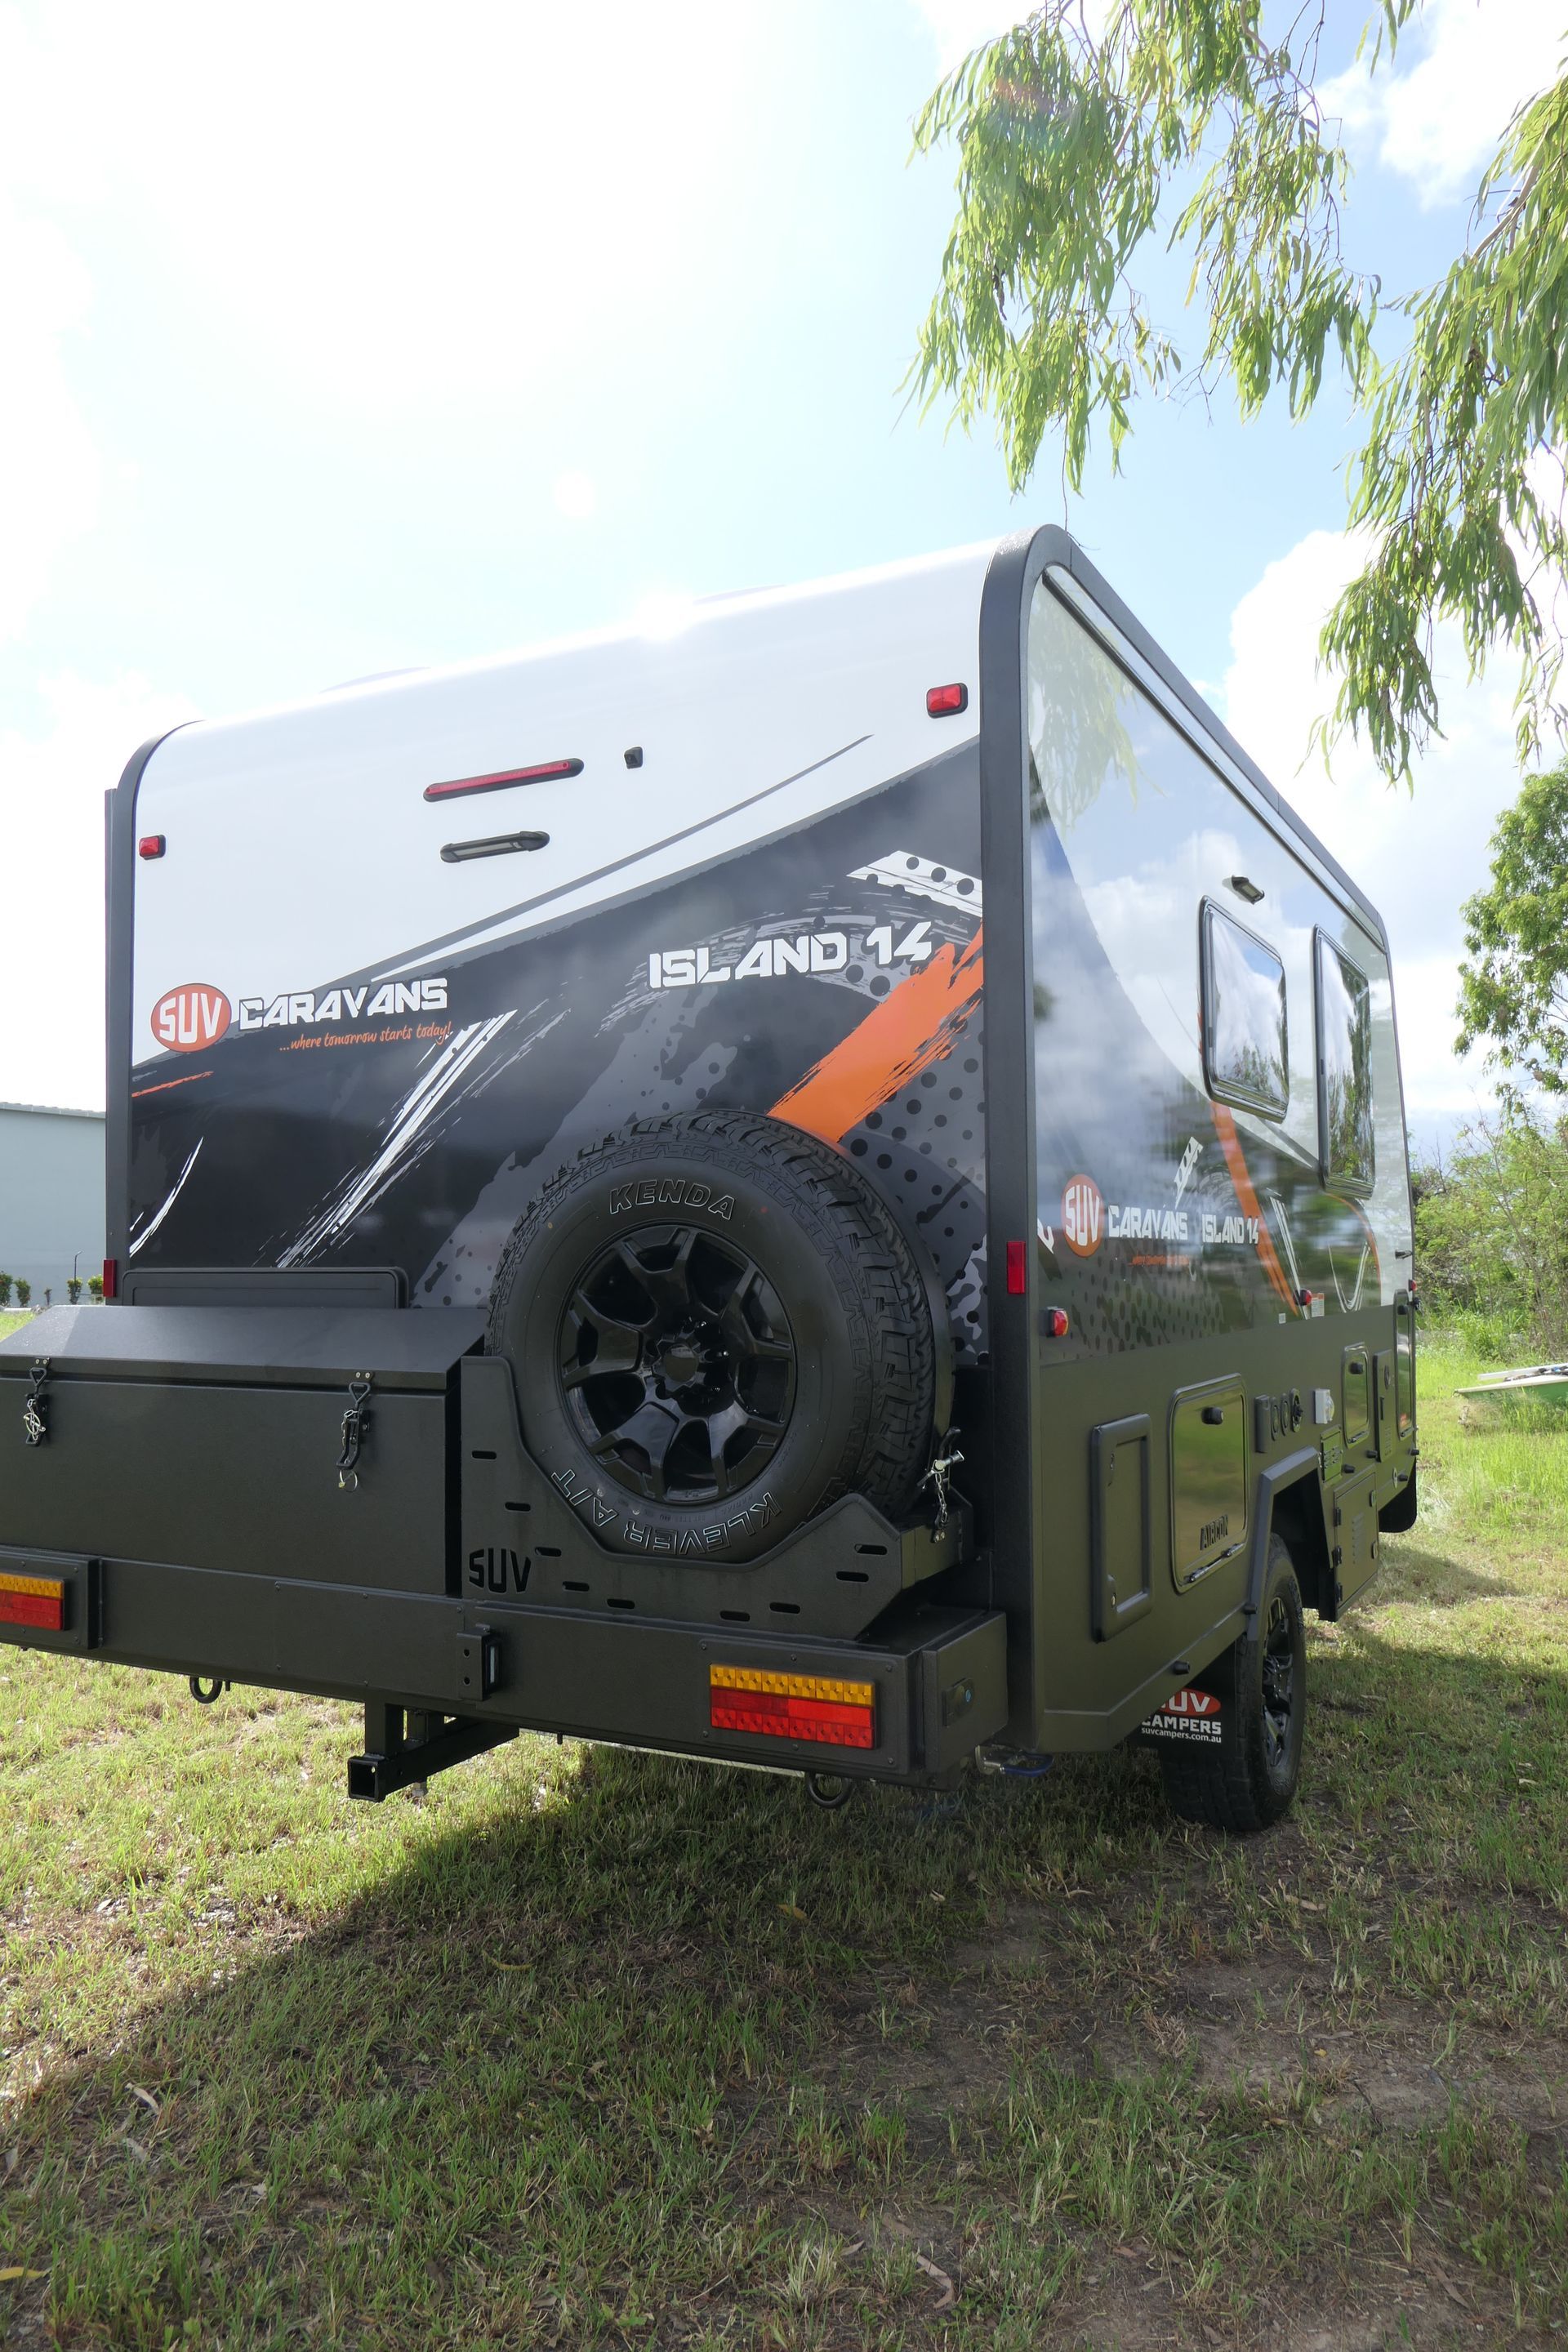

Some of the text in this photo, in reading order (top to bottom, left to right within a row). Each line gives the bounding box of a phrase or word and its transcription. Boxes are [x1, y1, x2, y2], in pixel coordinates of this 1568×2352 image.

[649, 921, 932, 989] ISLAND 14
[158, 978, 448, 1044] SUV CARAVANS
[323, 1030, 376, 1047] tomorrow
[379, 1024, 412, 1042] starts
[416, 1020, 452, 1045] today!
[610, 1178, 734, 1221] KENDA
[1065, 1184, 1188, 1246] SUV CARAVANS
[1202, 1214, 1259, 1244] ISLAND 14
[550, 1469, 782, 1555] KLEVER A/T
[1200, 1514, 1228, 1551] AIRCON
[469, 1548, 532, 1593] SUV
[1161, 1690, 1210, 1713] UV
[1142, 1726, 1222, 1744] suvcampers.com.au
